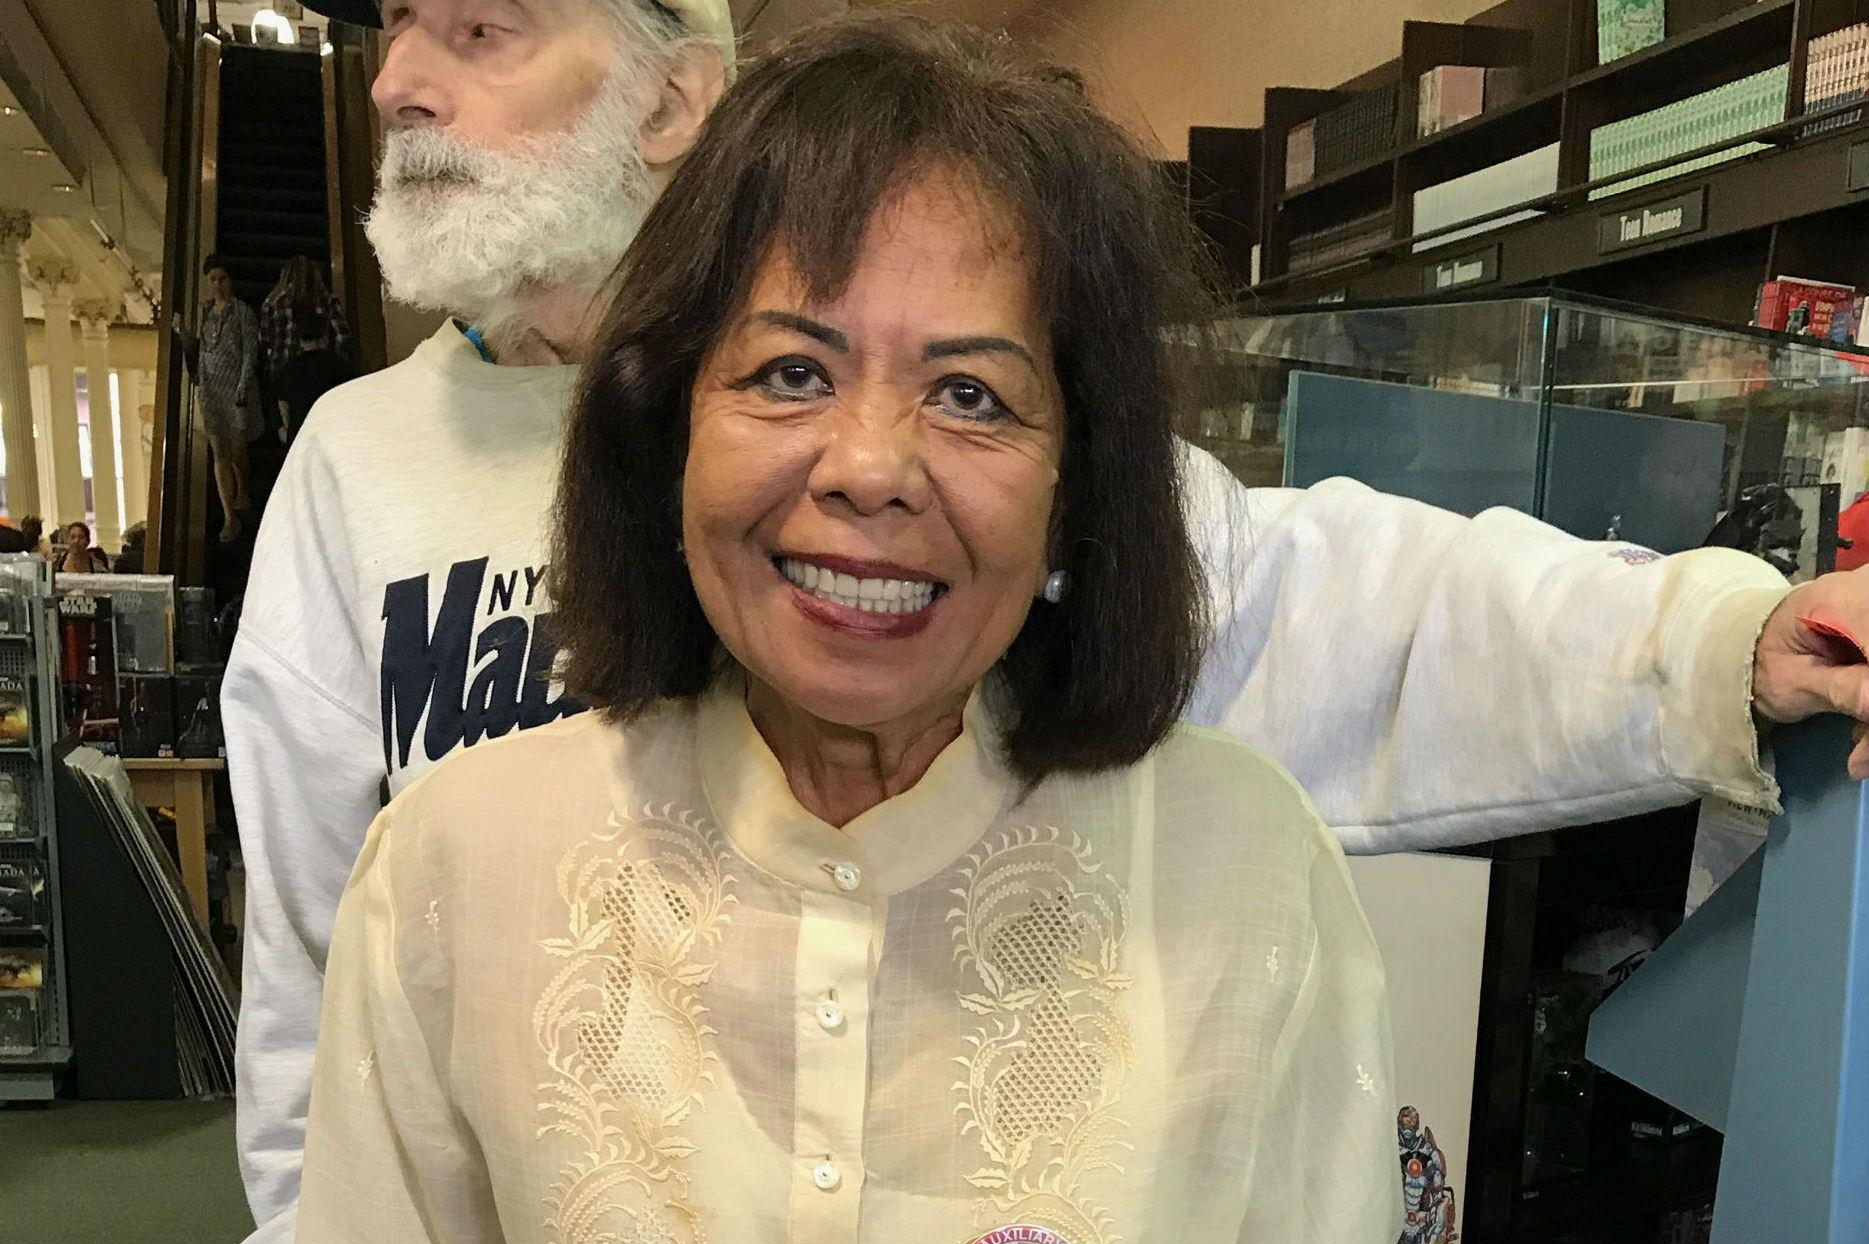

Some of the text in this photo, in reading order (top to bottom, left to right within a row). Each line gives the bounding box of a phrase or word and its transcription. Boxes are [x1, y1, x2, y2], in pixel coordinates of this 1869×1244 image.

[1642, 207, 1682, 236] Romance
[487, 564, 552, 616] NY
[58, 601, 98, 615] WARS
